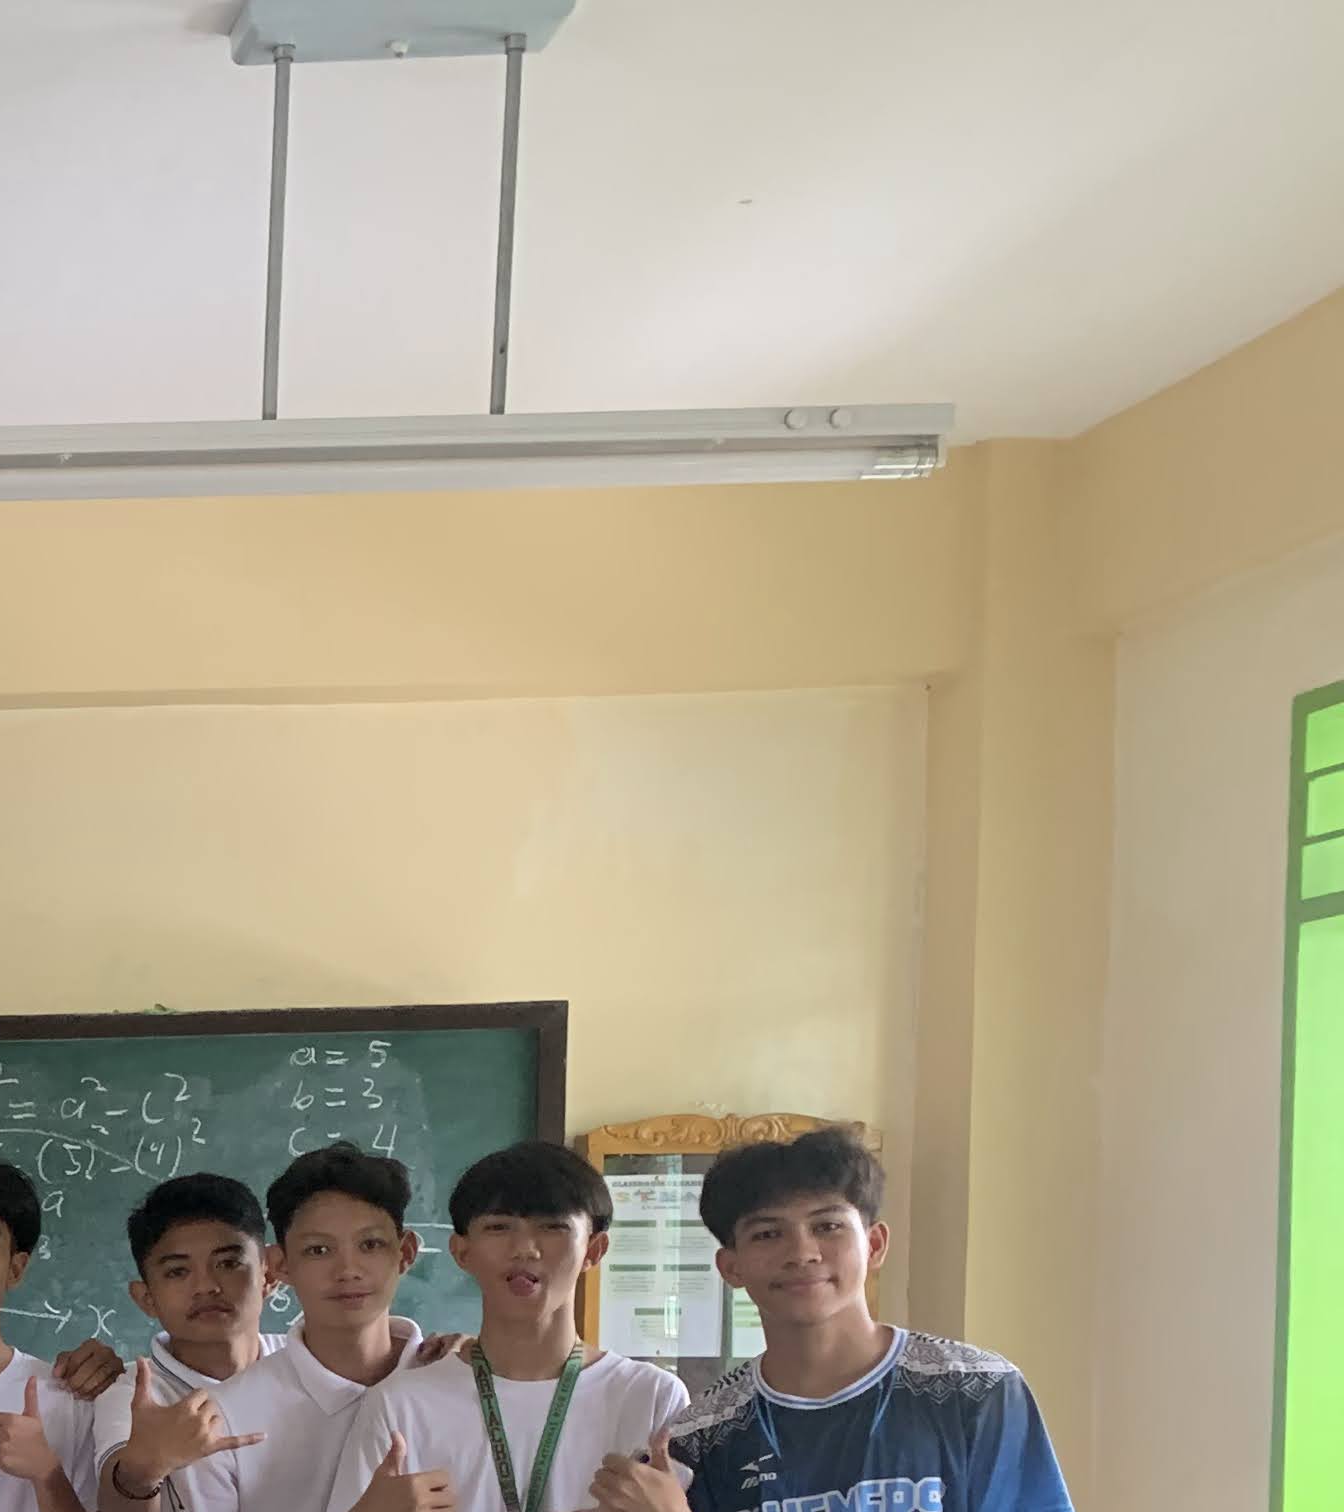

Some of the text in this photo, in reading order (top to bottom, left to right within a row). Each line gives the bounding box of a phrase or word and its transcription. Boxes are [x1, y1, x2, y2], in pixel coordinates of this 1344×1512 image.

[368, 1040, 392, 1069] 5
[290, 1079, 316, 1110] b
[360, 1078, 384, 1109] 3
[371, 1123, 398, 1159] 4
